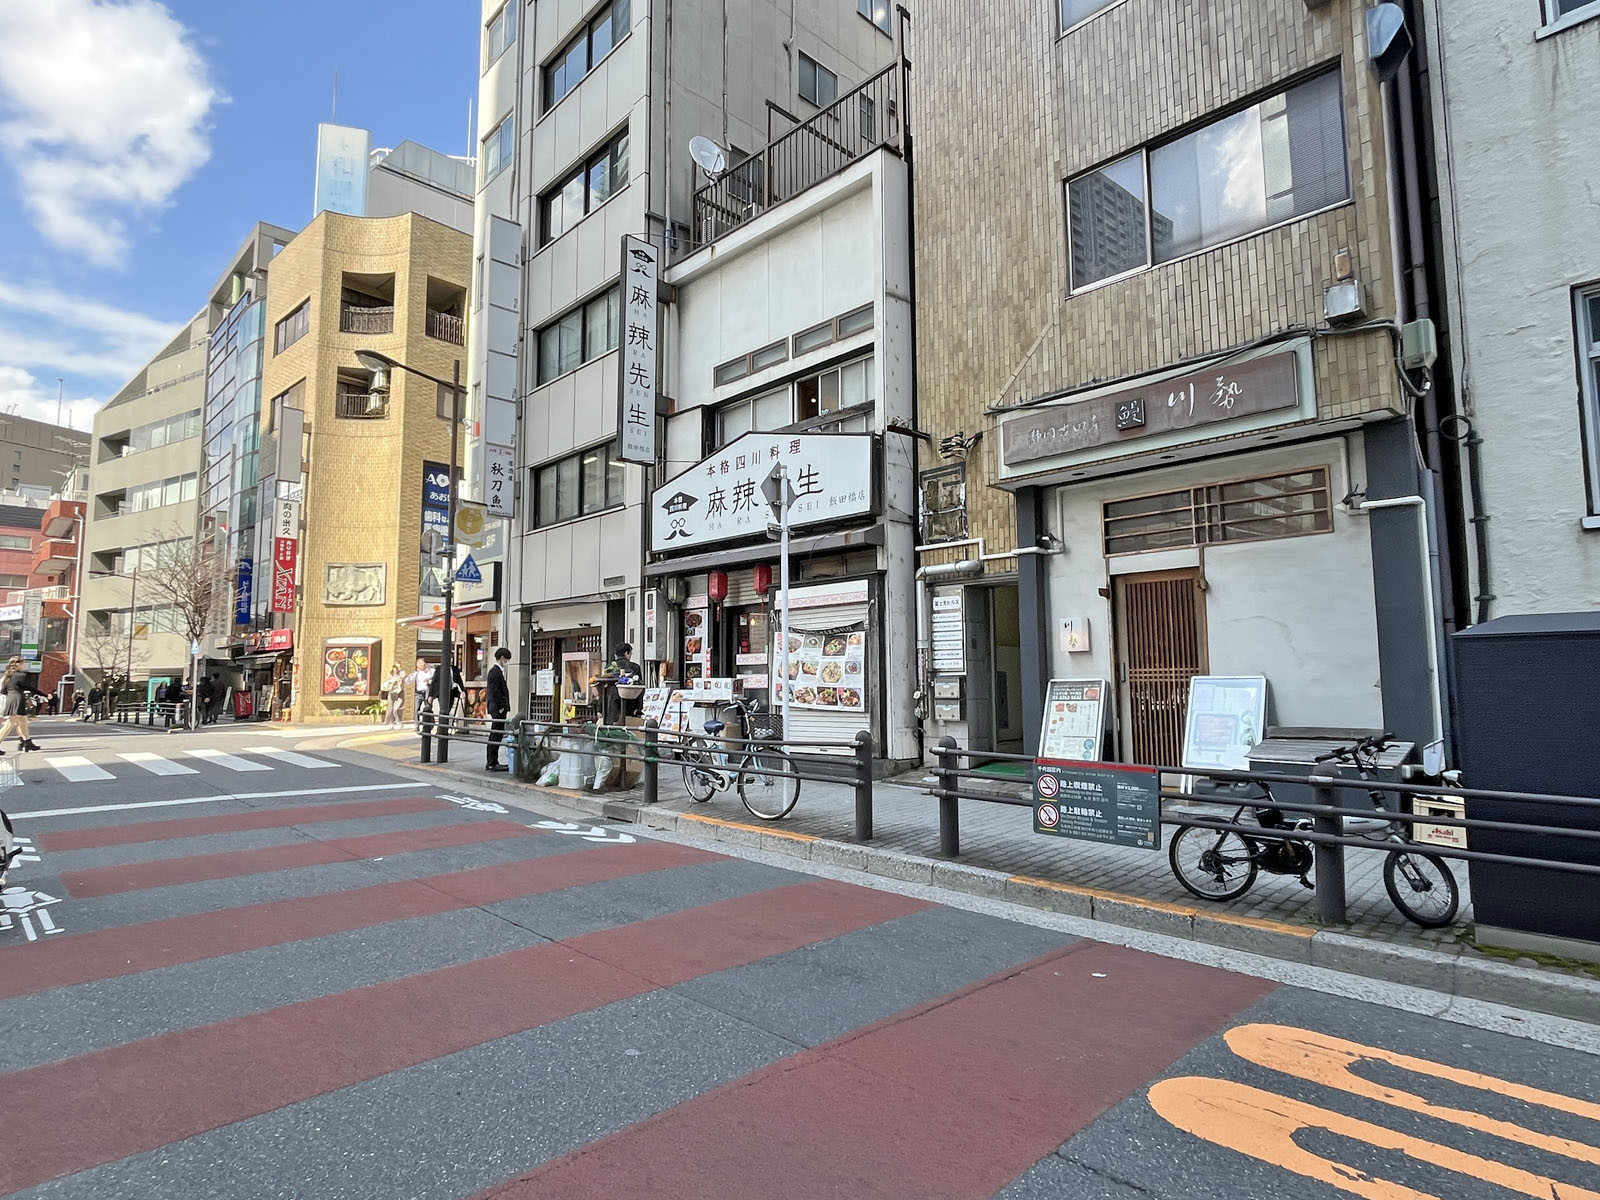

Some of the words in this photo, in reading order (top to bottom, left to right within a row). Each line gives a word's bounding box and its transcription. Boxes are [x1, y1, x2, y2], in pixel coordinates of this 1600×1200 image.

[627, 284, 653, 428] 麻辣先生
[706, 438, 802, 478] 本格四川料理
[490, 462, 504, 509] 秋刀魚
[704, 464, 824, 520] 麻辣生
[829, 488, 866, 508] 飯田橋店
[708, 520, 724, 531] MA
[736, 515, 751, 526] RA
[798, 502, 820, 513] SEI
[1060, 780, 1103, 792] 路上喫煙禁止
[1432, 827, 1454, 836] Asahi
